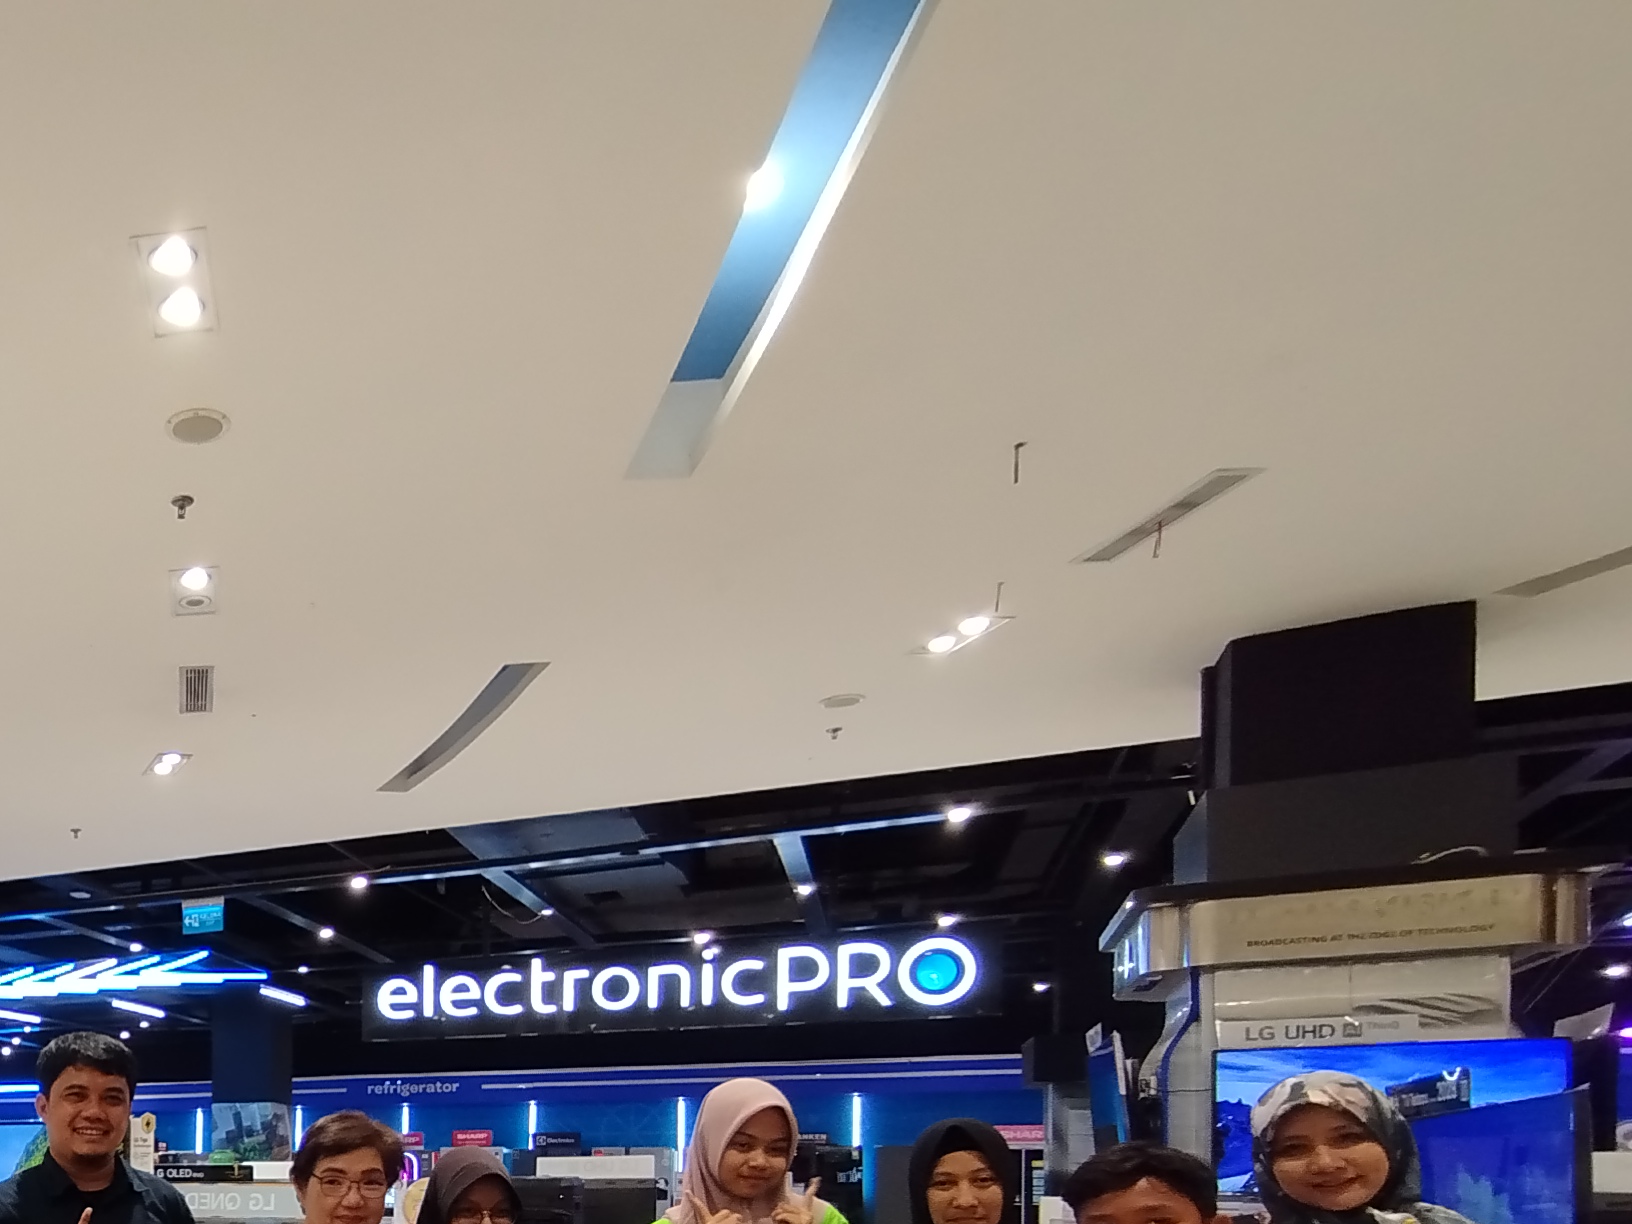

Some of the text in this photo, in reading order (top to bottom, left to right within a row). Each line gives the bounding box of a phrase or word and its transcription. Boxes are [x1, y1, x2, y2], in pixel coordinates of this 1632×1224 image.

[1247, 935, 1327, 947] BROADCASTING
[1418, 923, 1495, 936] TECHNOLOGY
[376, 937, 977, 1020] electronicPRO
[1245, 1024, 1275, 1042] LG
[1285, 1022, 1335, 1039] UHD
[367, 1080, 459, 1096] refrigerator
[1000, 1130, 1045, 1138] SHAR
[166, 1168, 193, 1178] OLED
